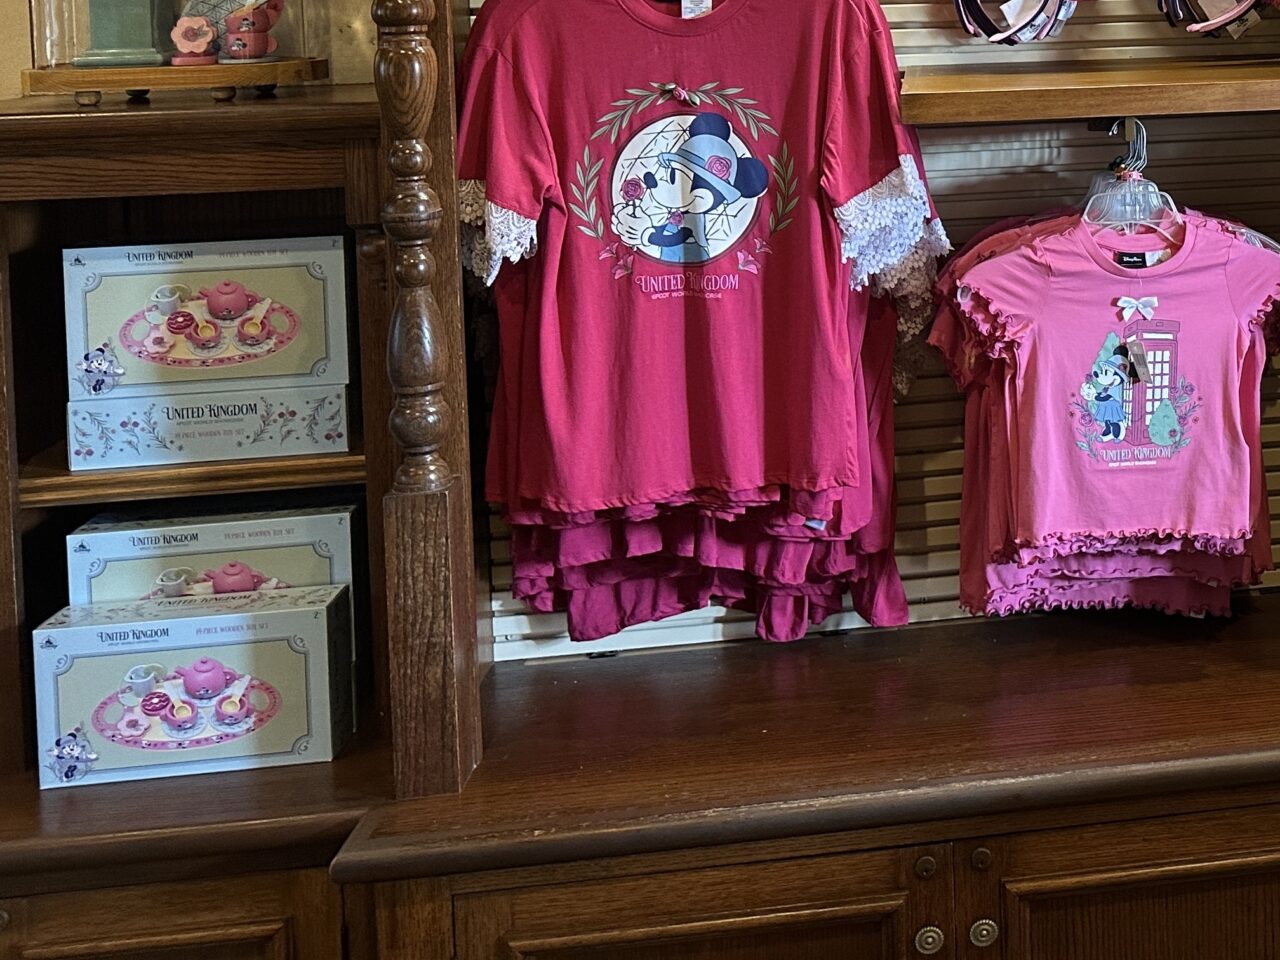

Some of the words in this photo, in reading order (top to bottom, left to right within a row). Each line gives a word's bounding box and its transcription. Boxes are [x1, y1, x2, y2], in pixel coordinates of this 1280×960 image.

[124, 251, 155, 262] UNITED
[155, 250, 194, 261] KINGDOM
[635, 274, 685, 292] UNITED
[686, 271, 739, 291] KINGDOM
[161, 405, 205, 421] UNITED
[205, 402, 258, 418] KINGDOM
[1100, 449, 1132, 461] UNITED
[1132, 446, 1171, 460] KINGDOM
[129, 536, 160, 547] UNITED
[160, 533, 199, 544] KINGDOM
[97, 631, 129, 643] UNITED
[129, 628, 170, 640] KINGDOM
